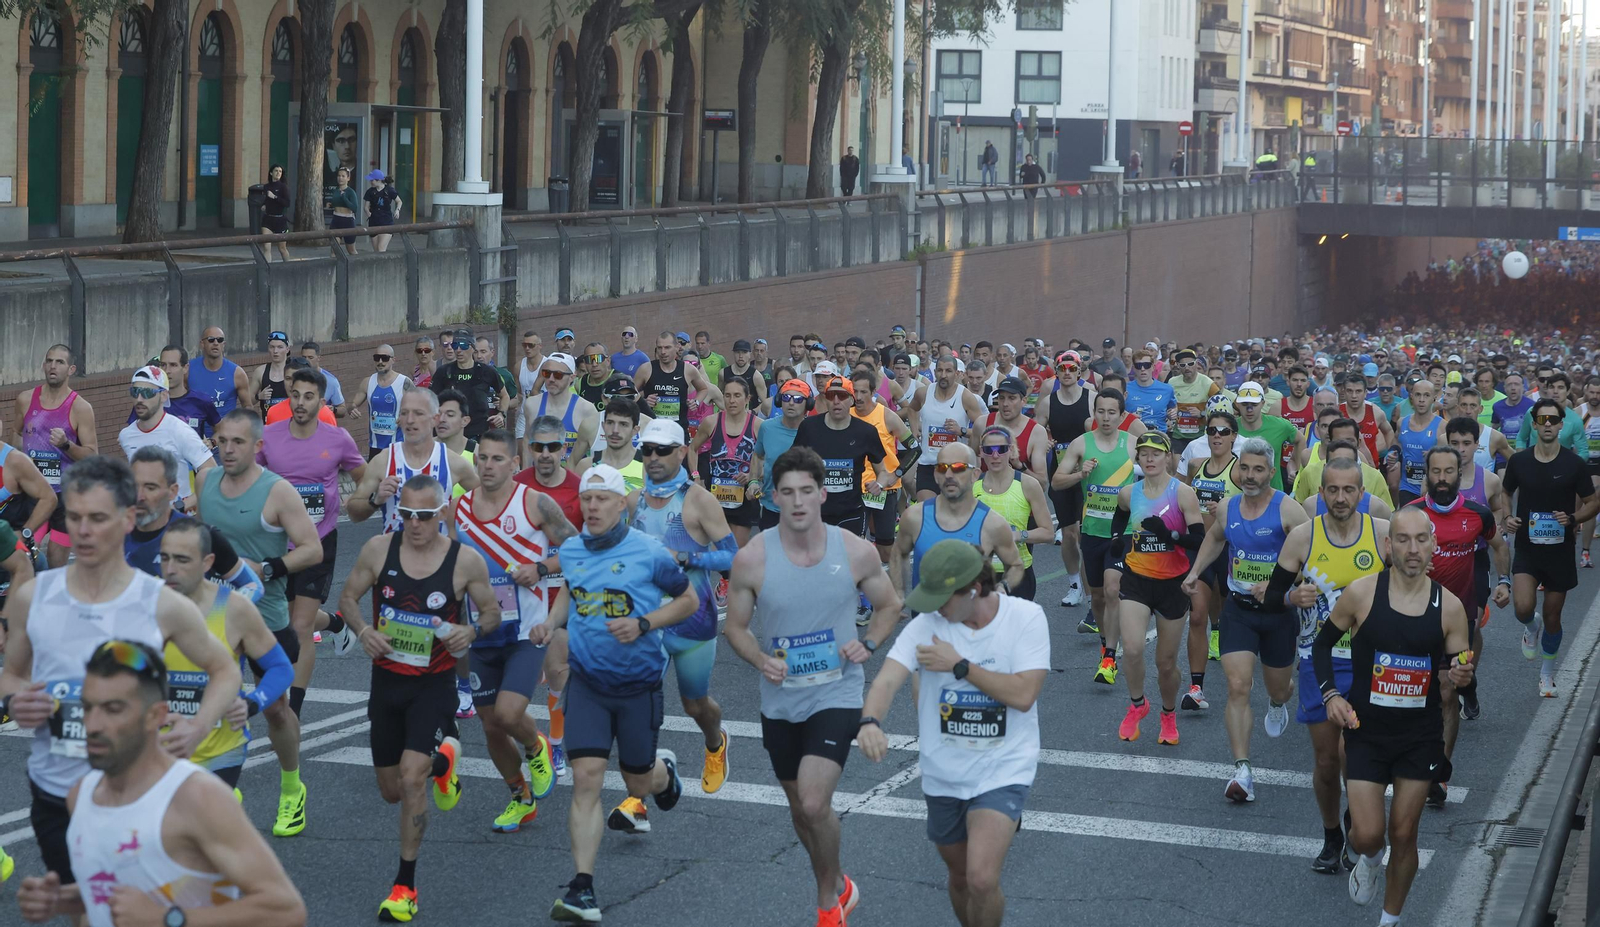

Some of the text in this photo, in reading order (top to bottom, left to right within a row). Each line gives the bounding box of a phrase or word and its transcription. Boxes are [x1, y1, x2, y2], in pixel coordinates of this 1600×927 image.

[1099, 486, 1120, 494] ZURICH
[1140, 543, 1166, 552] SALTIE
[1247, 552, 1272, 561] ZURICH
[397, 614, 430, 626] ZURICH
[396, 627, 413, 639] 1313
[792, 633, 828, 647] ZURICH
[797, 651, 816, 660] 7703
[790, 659, 829, 675] JAMES
[1394, 657, 1426, 668] ZURICH
[174, 674, 209, 683] ZURICH
[1393, 673, 1411, 682] 1088
[1377, 681, 1424, 696] TVINTEM
[962, 711, 983, 721] 4225
[947, 721, 1000, 736] EUGENIO
